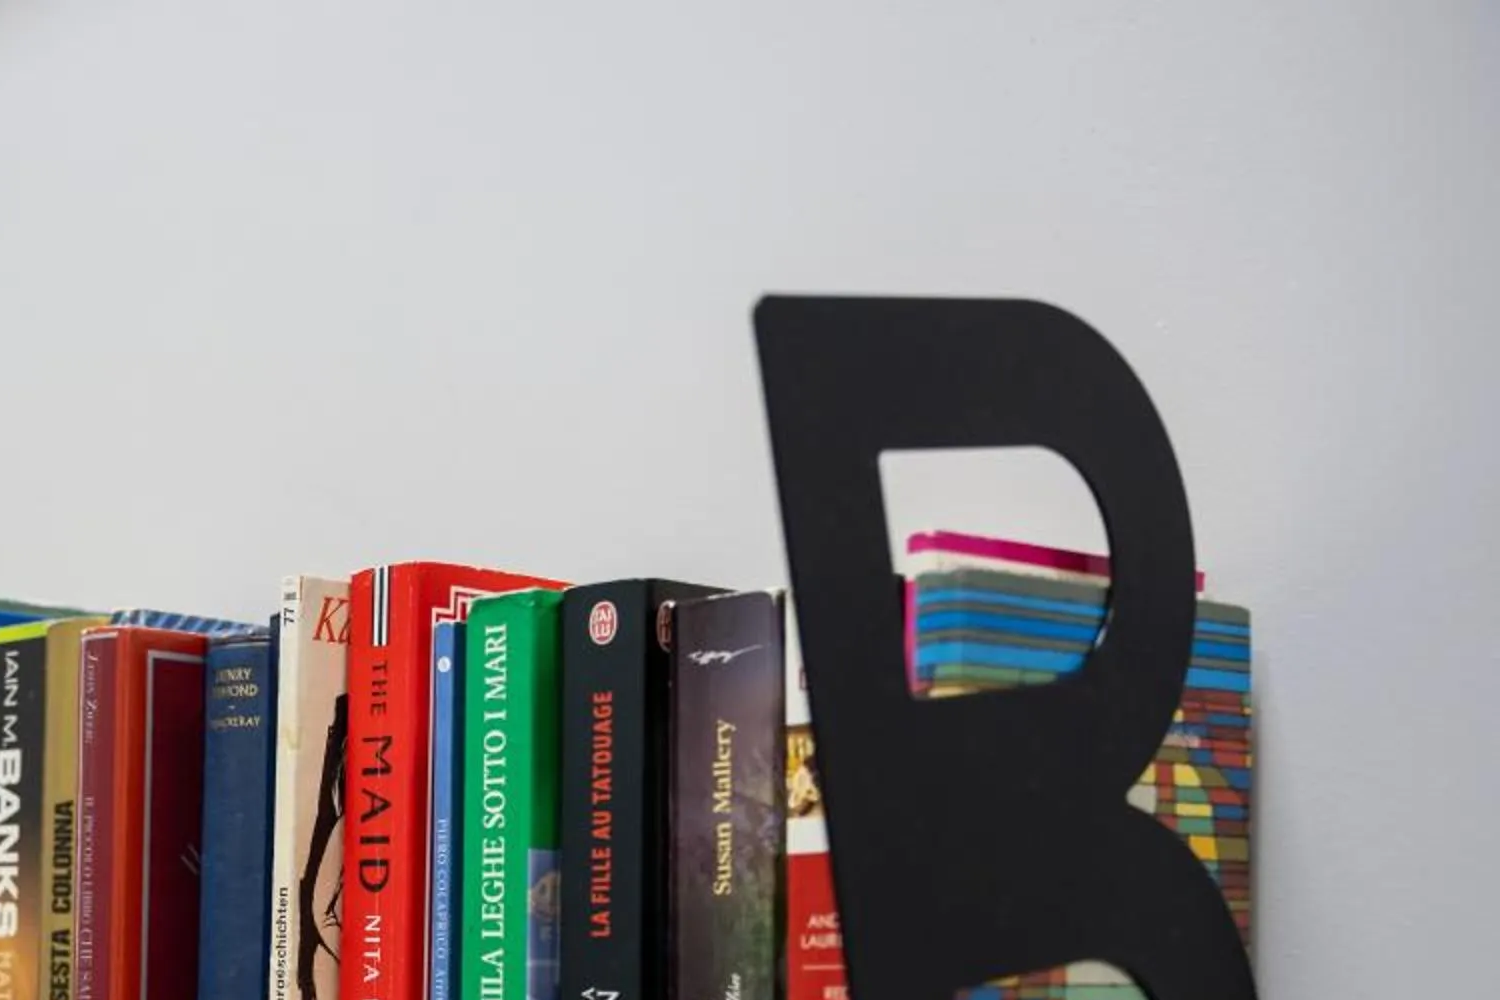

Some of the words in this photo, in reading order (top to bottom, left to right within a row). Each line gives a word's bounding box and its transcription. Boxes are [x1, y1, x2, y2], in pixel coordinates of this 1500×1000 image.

[3, 650, 20, 707] IAIN
[213, 684, 258, 698] MOND
[371, 660, 388, 716] THE
[484, 623, 507, 701] MARI
[1, 714, 17, 746] M.
[483, 709, 507, 722] I
[592, 691, 613, 805] TATOUAGE
[712, 719, 736, 814] Mallery
[483, 729, 507, 829] SOTTO
[360, 735, 392, 893] MAID
[437, 818, 449, 865] PIERO
[591, 811, 611, 840] AU
[50, 799, 74, 915] COLONNA
[591, 847, 611, 905] FILLE
[712, 822, 732, 896] Susan
[481, 836, 506, 939] LEGHE
[80, 927, 93, 962] CHE
[362, 914, 381, 982] NITA
[591, 911, 610, 938] LA
